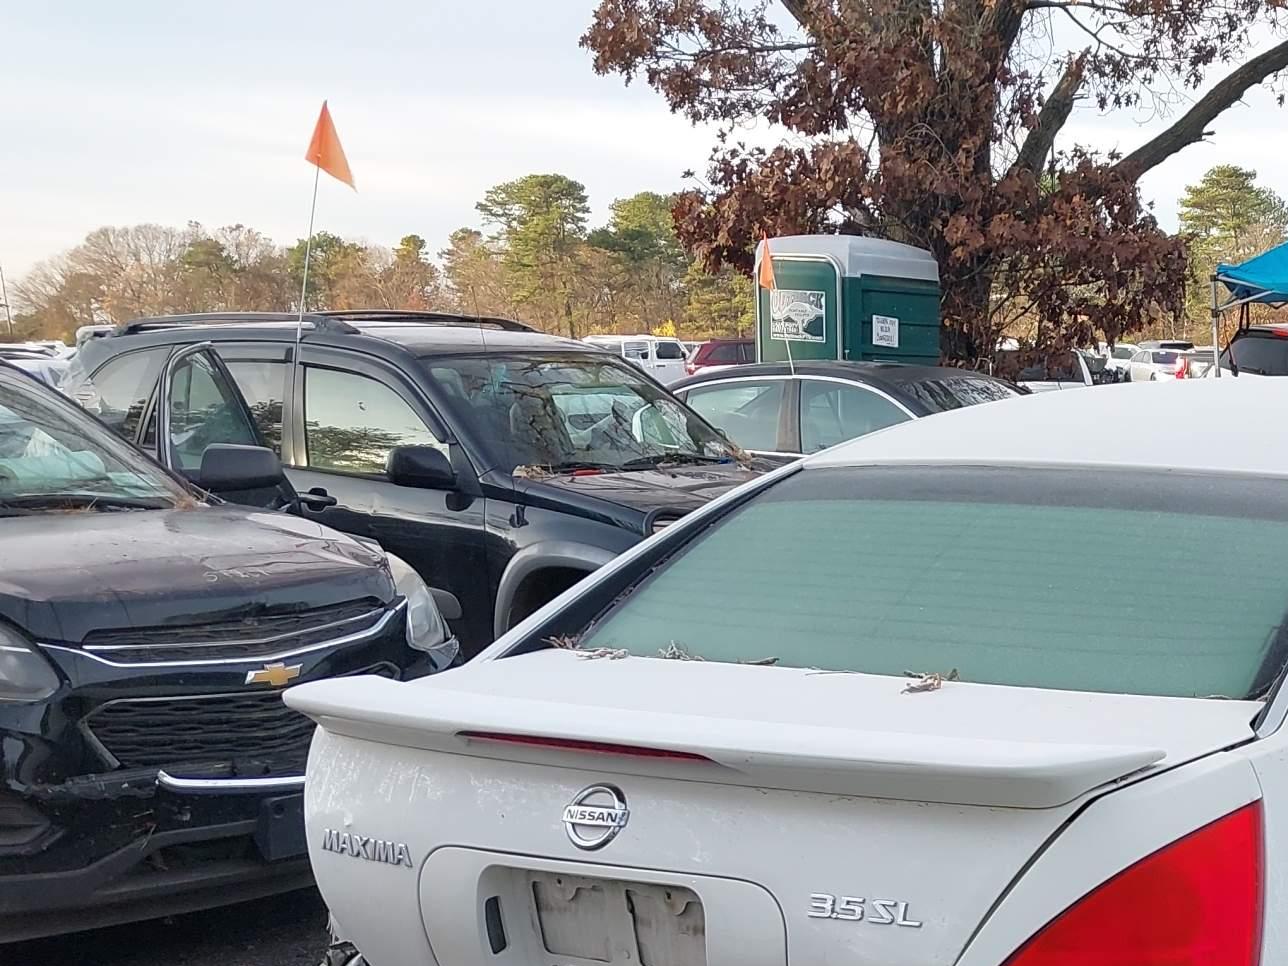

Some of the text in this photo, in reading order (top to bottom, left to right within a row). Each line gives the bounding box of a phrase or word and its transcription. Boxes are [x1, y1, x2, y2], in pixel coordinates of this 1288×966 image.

[566, 808, 617, 823] NISSAN
[321, 829, 413, 868] MAXIMA
[807, 892, 922, 928] 3.5 SL
